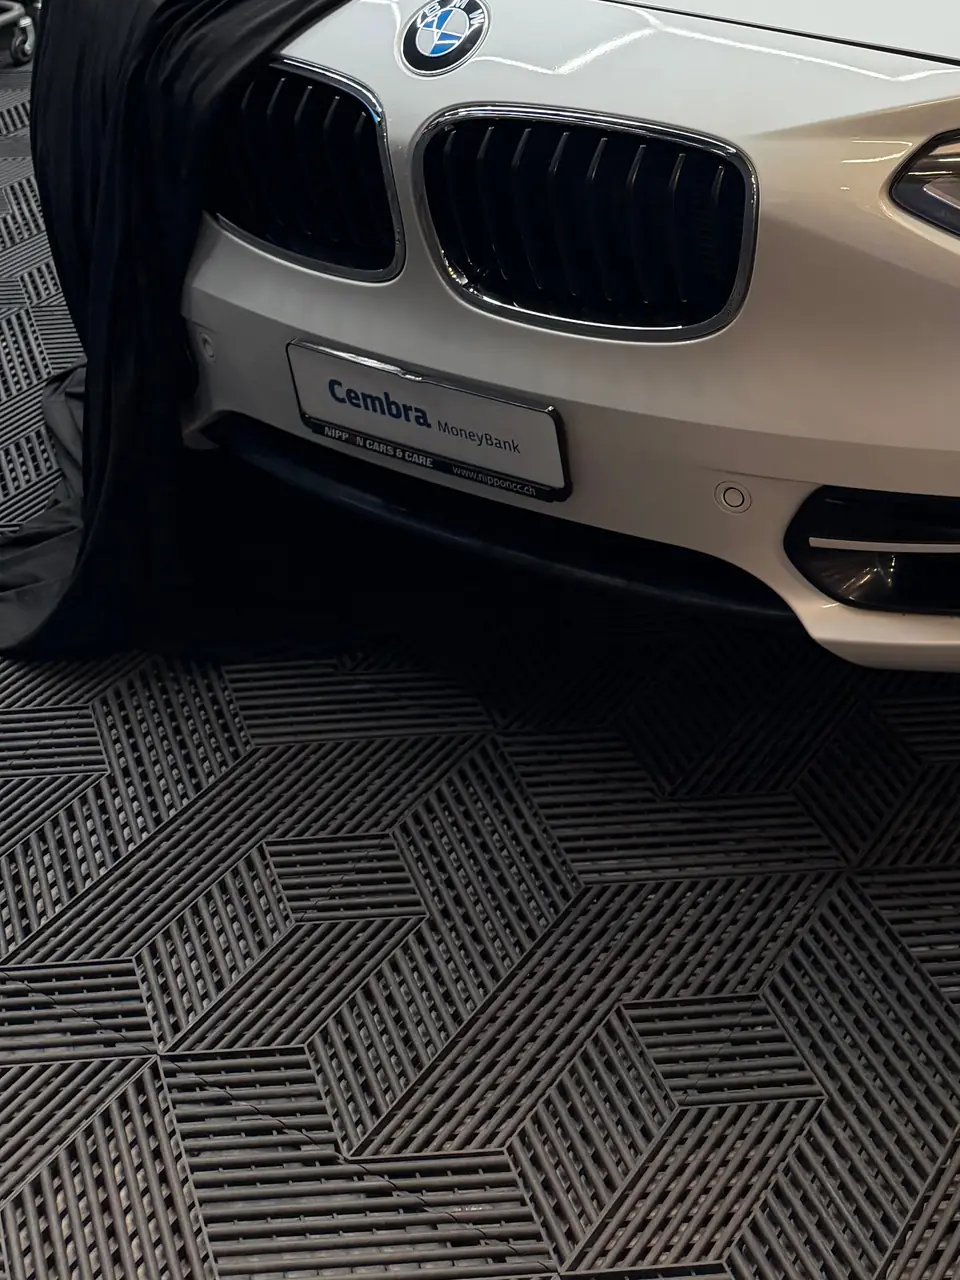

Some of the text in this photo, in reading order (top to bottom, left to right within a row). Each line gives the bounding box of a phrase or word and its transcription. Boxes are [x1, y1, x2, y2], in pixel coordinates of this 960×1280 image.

[328, 379, 522, 455] Cembra MoneyBank
[366, 439, 394, 456] CARS
[395, 448, 403, 458] &
[404, 451, 434, 468] CARE
[452, 465, 537, 497] www.nipponcc.ch
